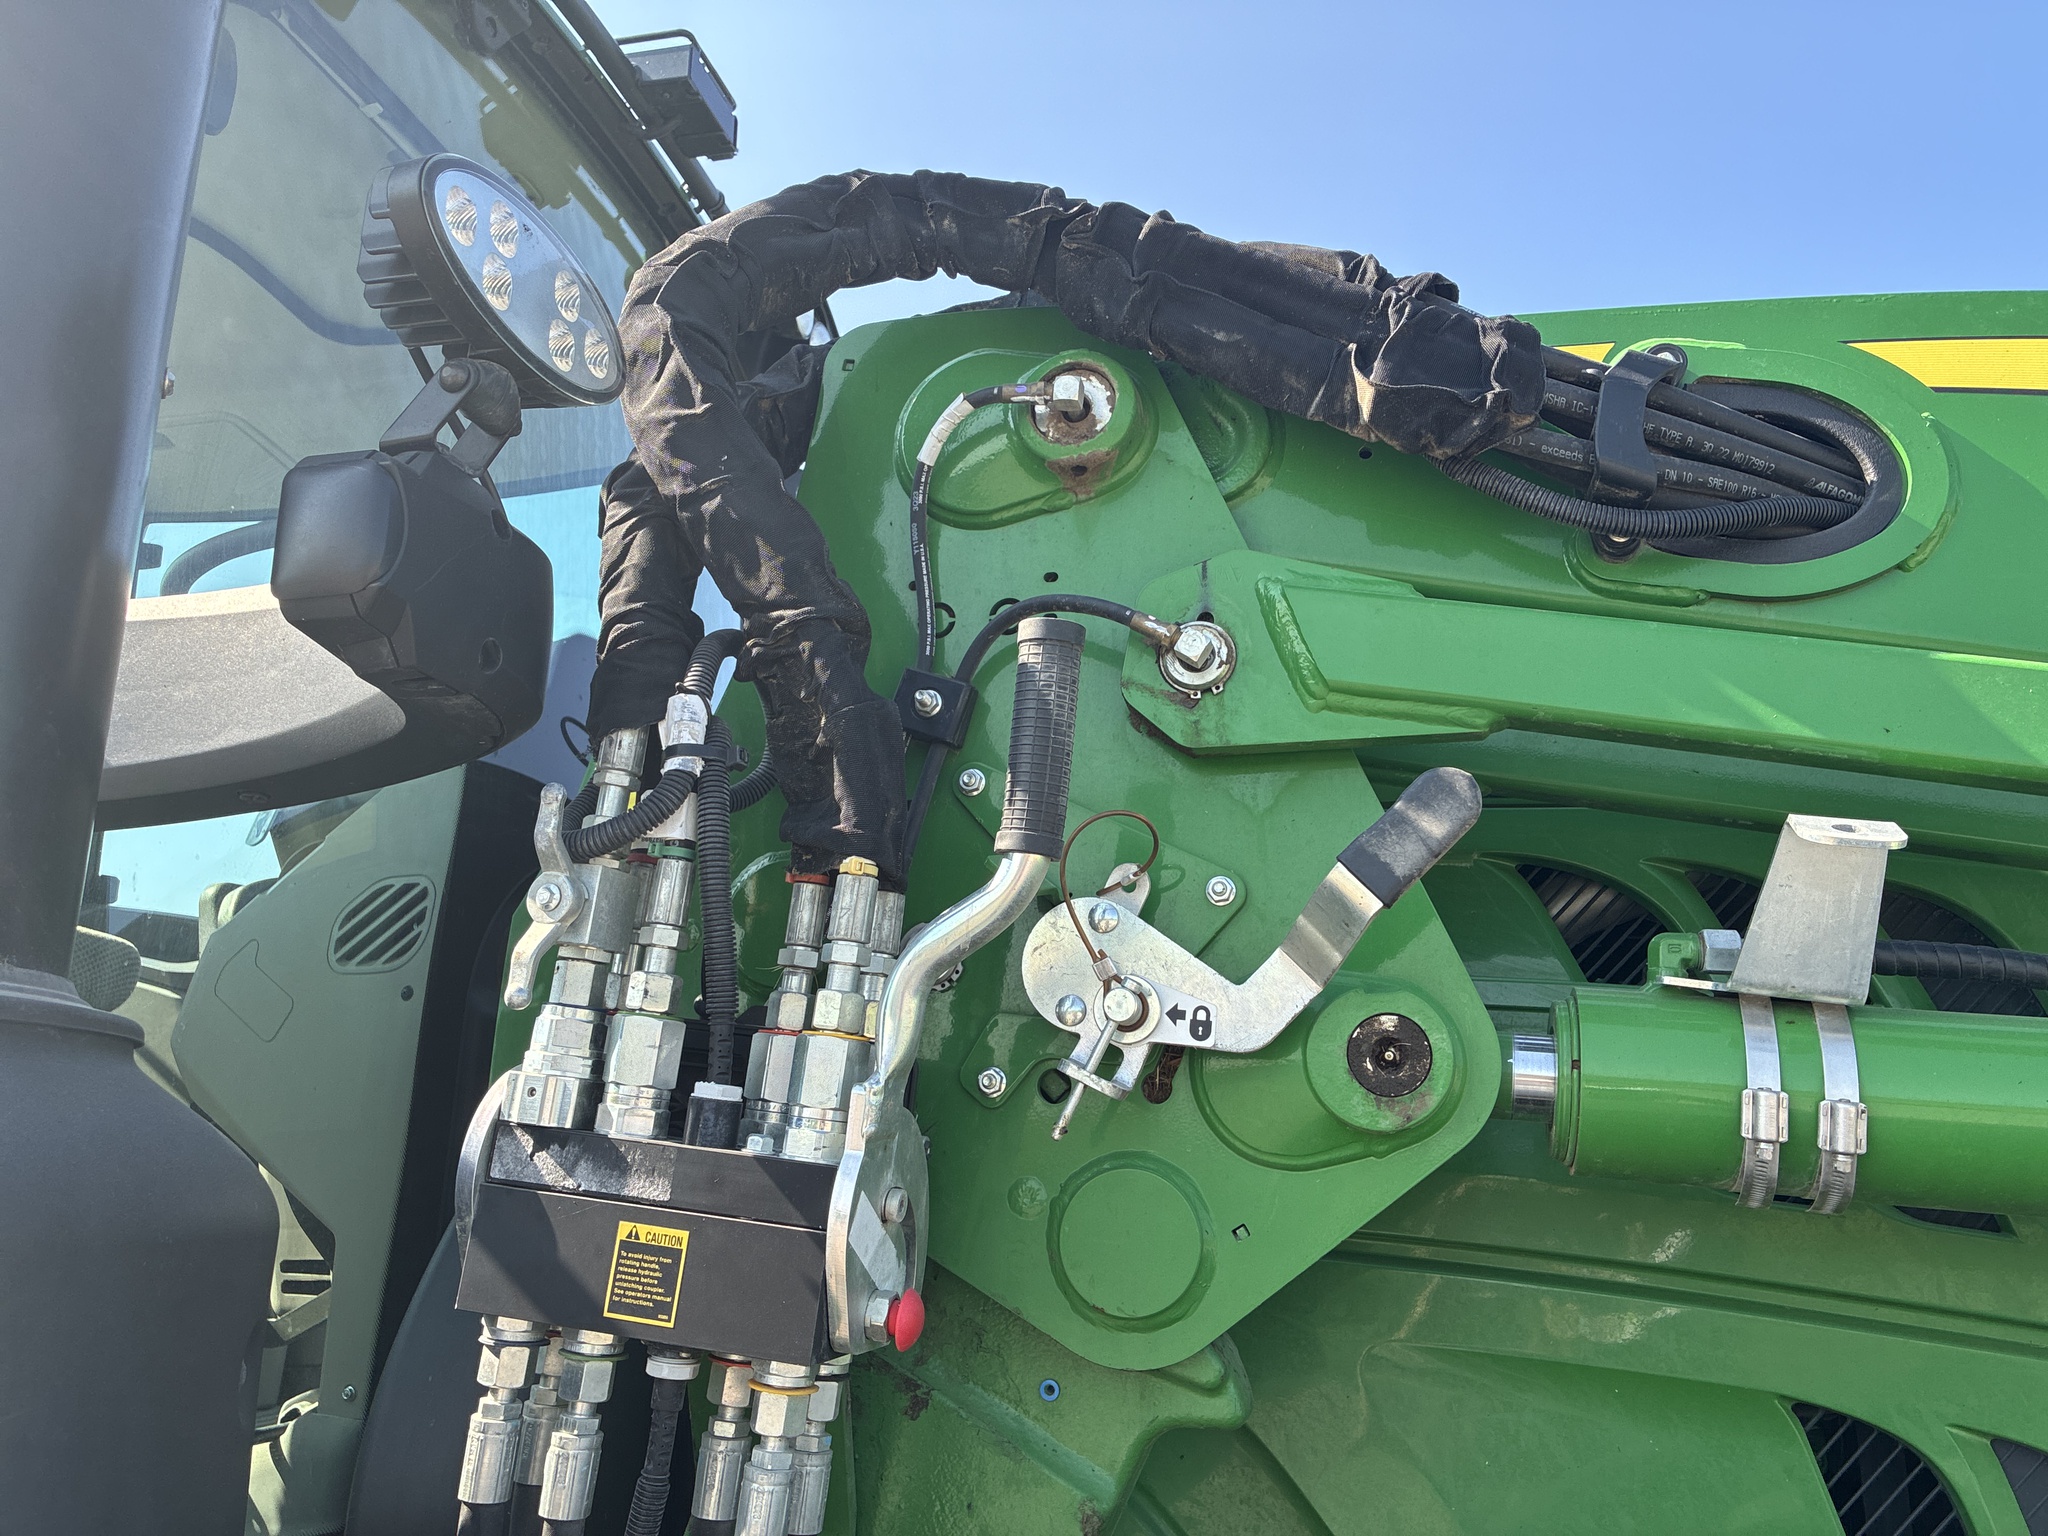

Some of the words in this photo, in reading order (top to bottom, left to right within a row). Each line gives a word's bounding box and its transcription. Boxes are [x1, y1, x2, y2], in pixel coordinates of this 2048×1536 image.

[1660, 426, 1683, 444] TYPE
[1541, 444, 1584, 463] exceeds
[1664, 468, 1678, 481] DN
[1682, 472, 1693, 483] 10
[1707, 476, 1738, 495] SAE100
[1740, 484, 1758, 499] R16
[646, 1232, 682, 1247] CAUTION
[619, 1259, 639, 1267] rotating
[639, 1268, 662, 1277] hydraulic
[615, 1281, 642, 1290] unlatching
[622, 1298, 654, 1307] instructions.
